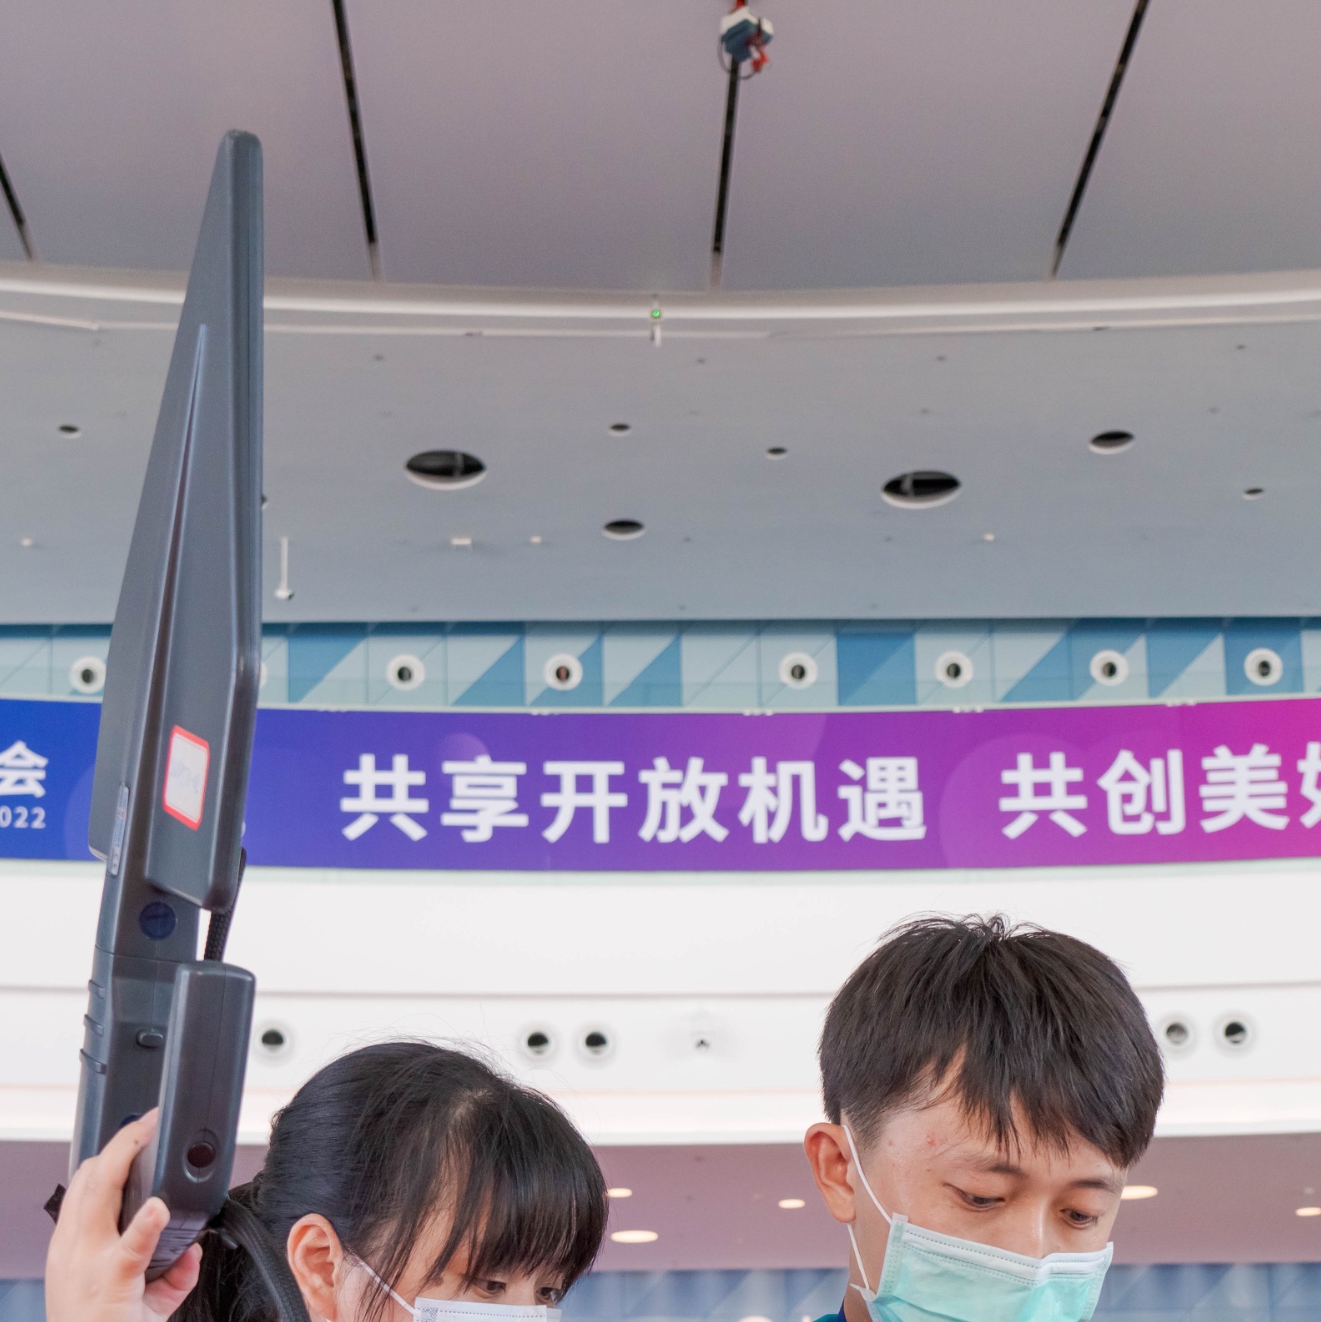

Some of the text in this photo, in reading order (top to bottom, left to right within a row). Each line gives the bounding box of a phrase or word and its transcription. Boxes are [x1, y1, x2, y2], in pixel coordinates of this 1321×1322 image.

[340, 753, 927, 844] 共享开放机遇
